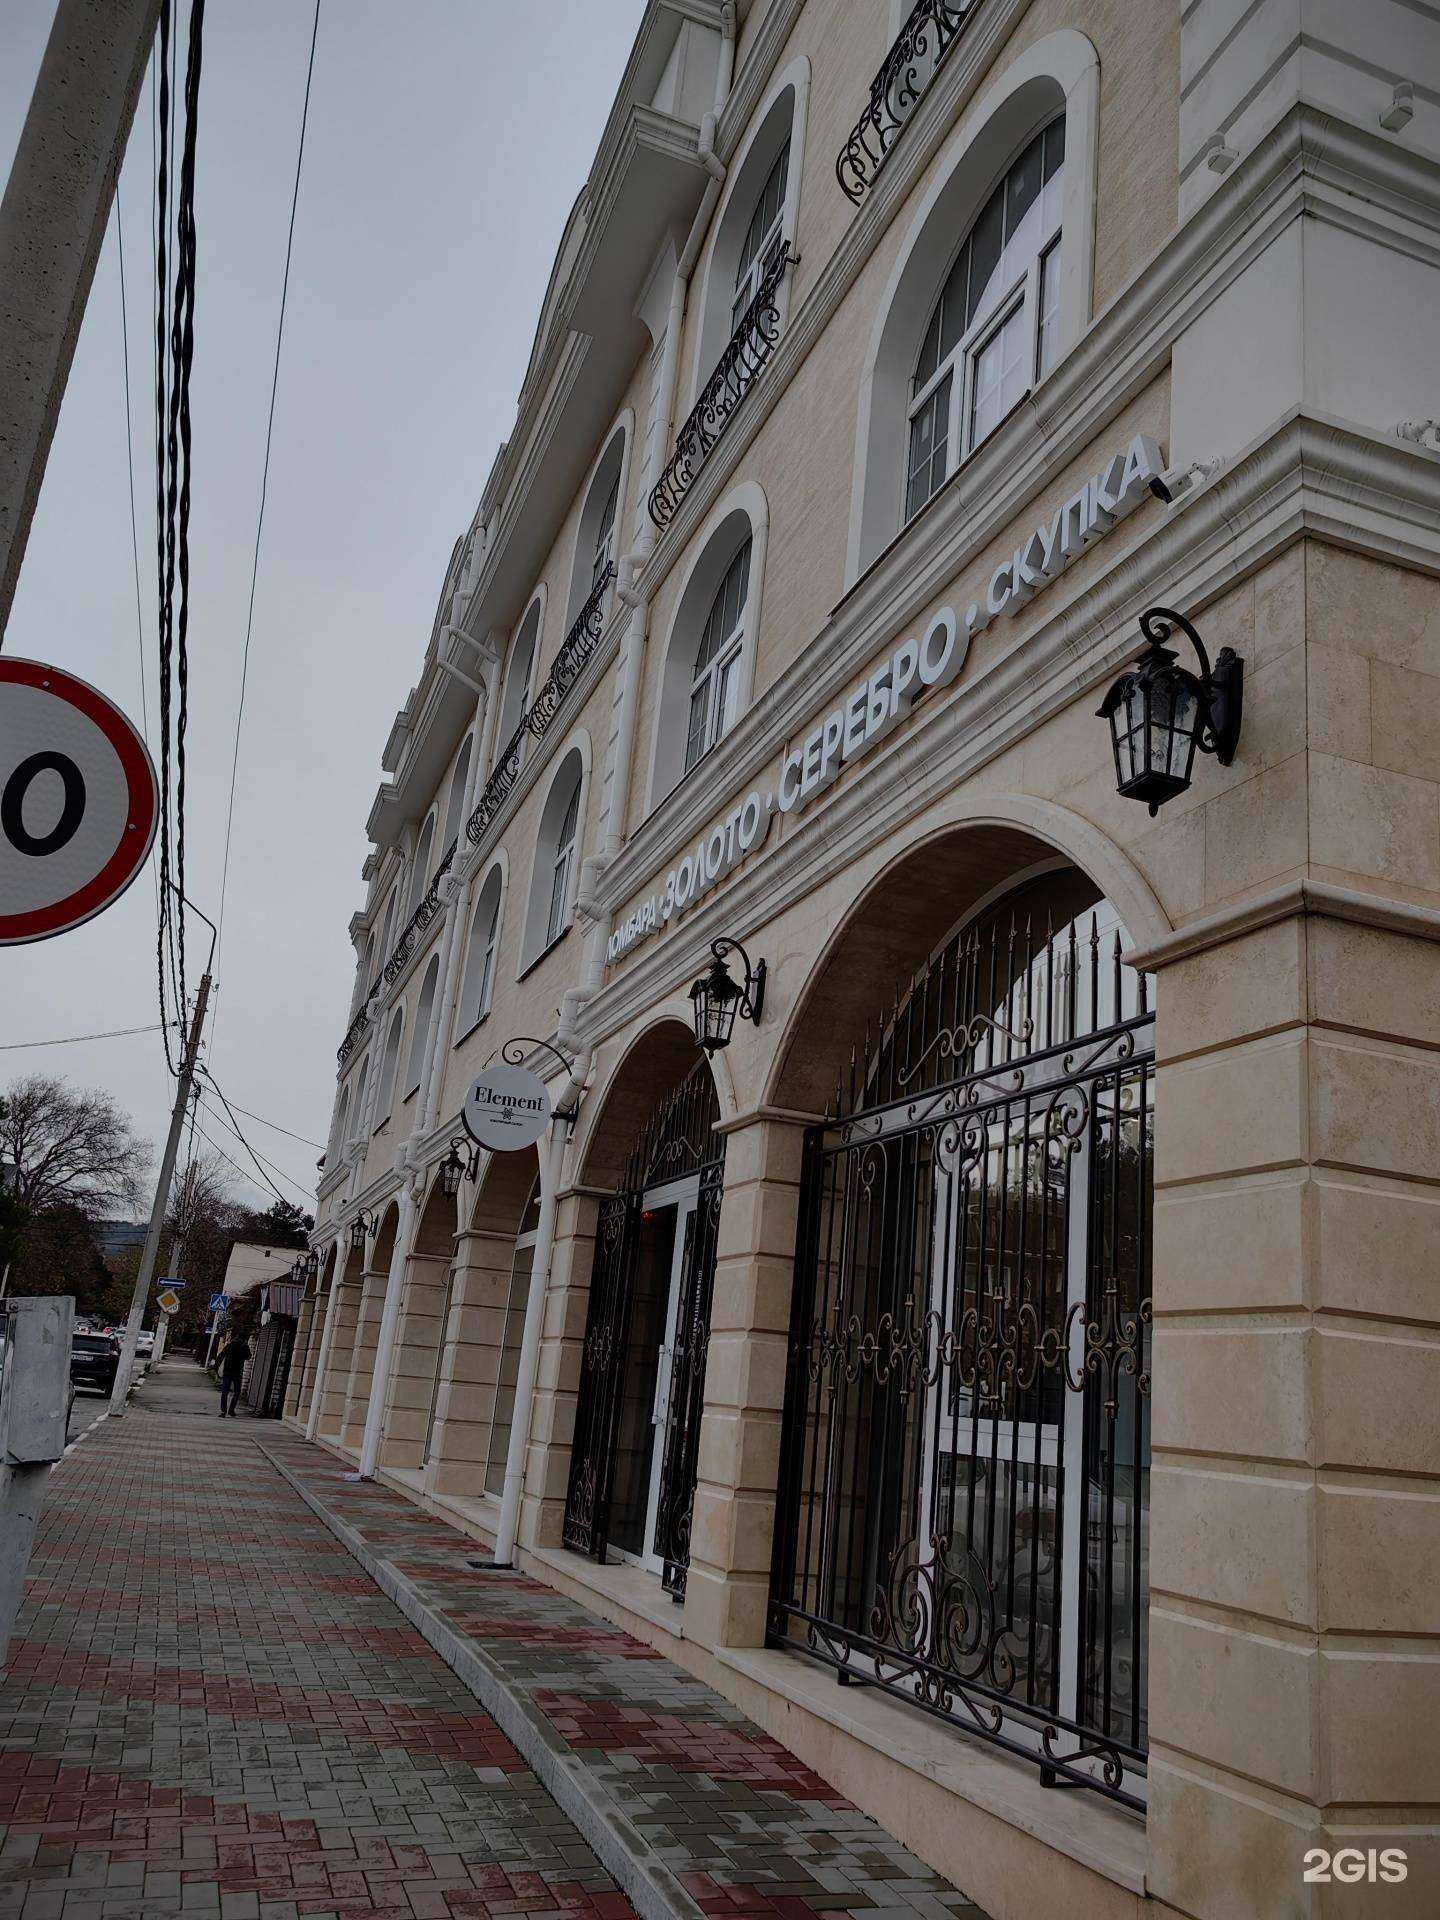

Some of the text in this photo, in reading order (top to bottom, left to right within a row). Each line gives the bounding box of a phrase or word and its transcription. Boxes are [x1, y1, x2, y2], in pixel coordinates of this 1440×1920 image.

[661, 791, 760, 920] ЗОЛОТО
[778, 606, 957, 813] СЕРЕБРО
[987, 433, 1153, 614] СКУПКА
[474, 1086, 545, 1112] Element
